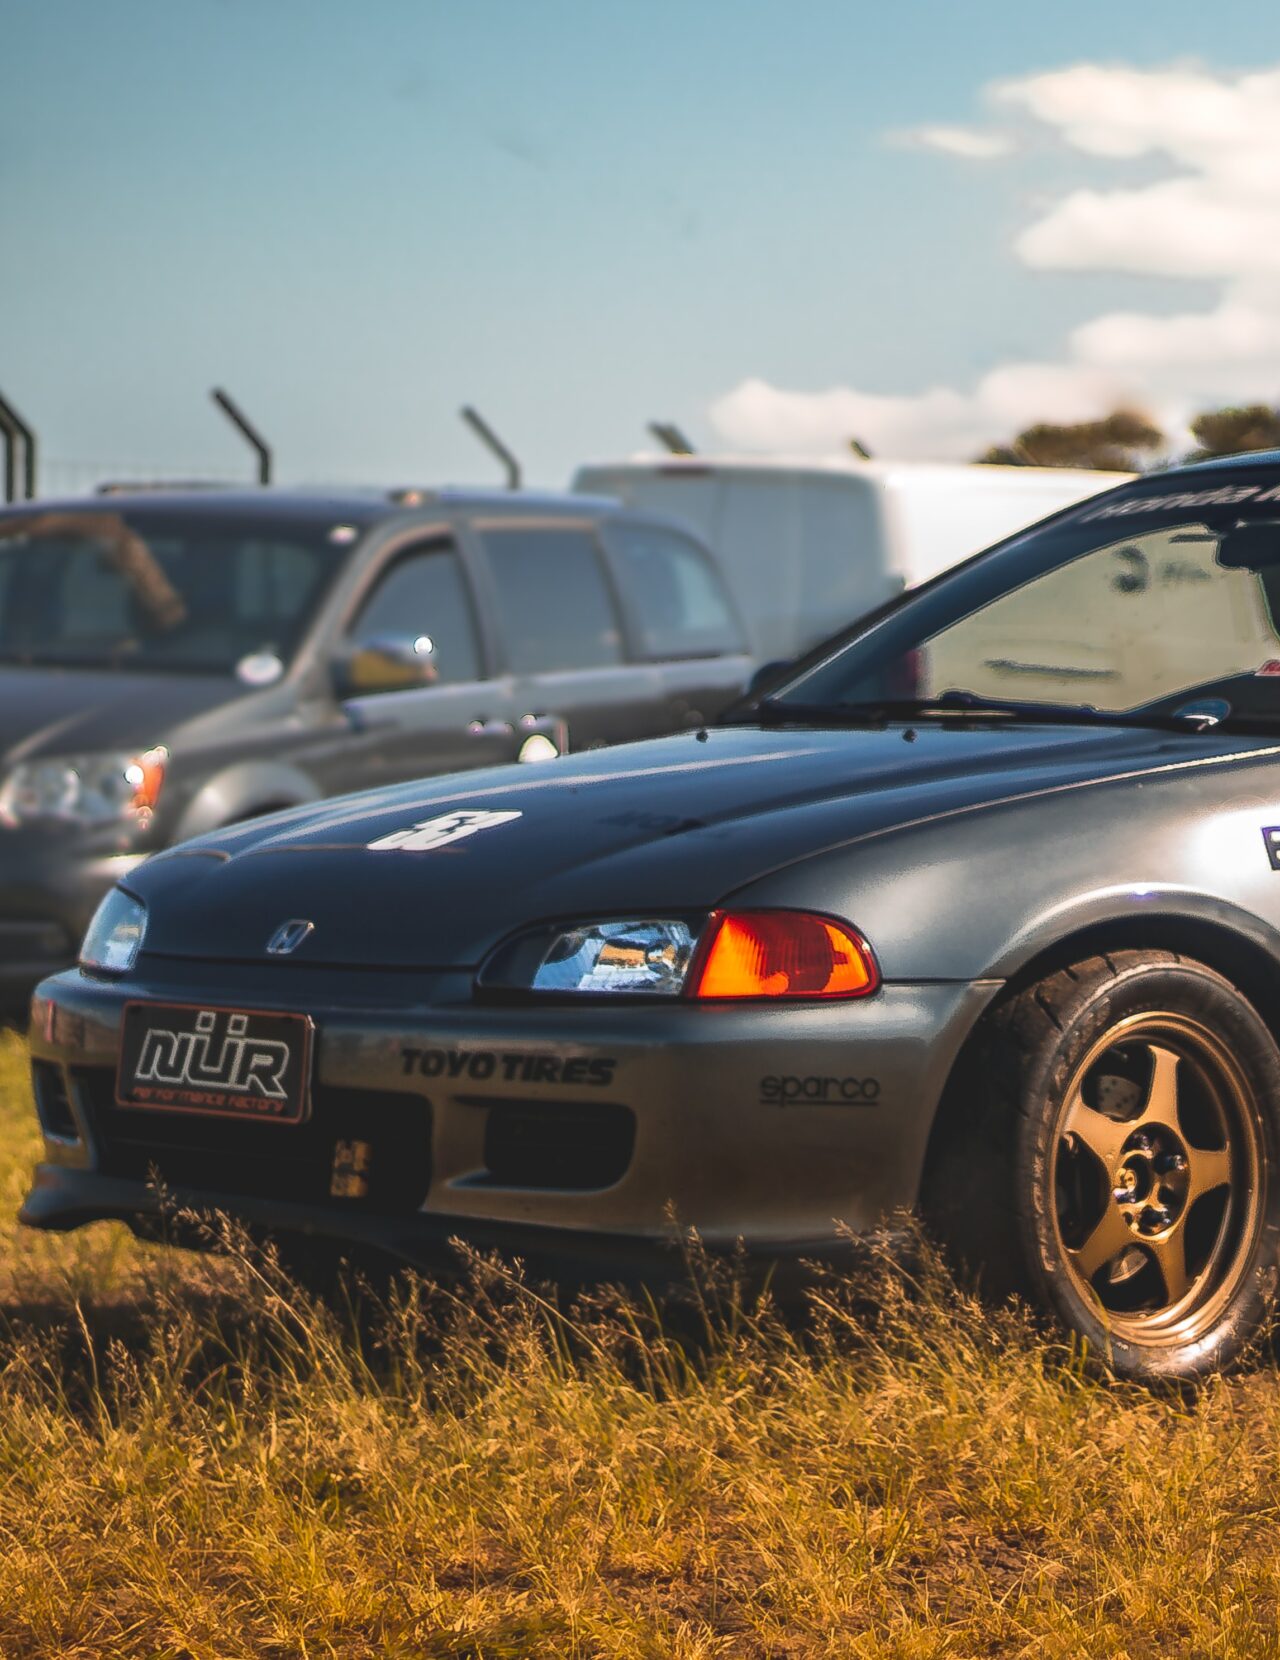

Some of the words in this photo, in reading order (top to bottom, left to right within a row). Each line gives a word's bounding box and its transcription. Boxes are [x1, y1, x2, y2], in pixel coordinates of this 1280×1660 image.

[134, 1010, 288, 1099] NÜR
[400, 1047, 499, 1079] TOYO
[502, 1054, 617, 1087] TIRES
[760, 1073, 880, 1107] sparco
